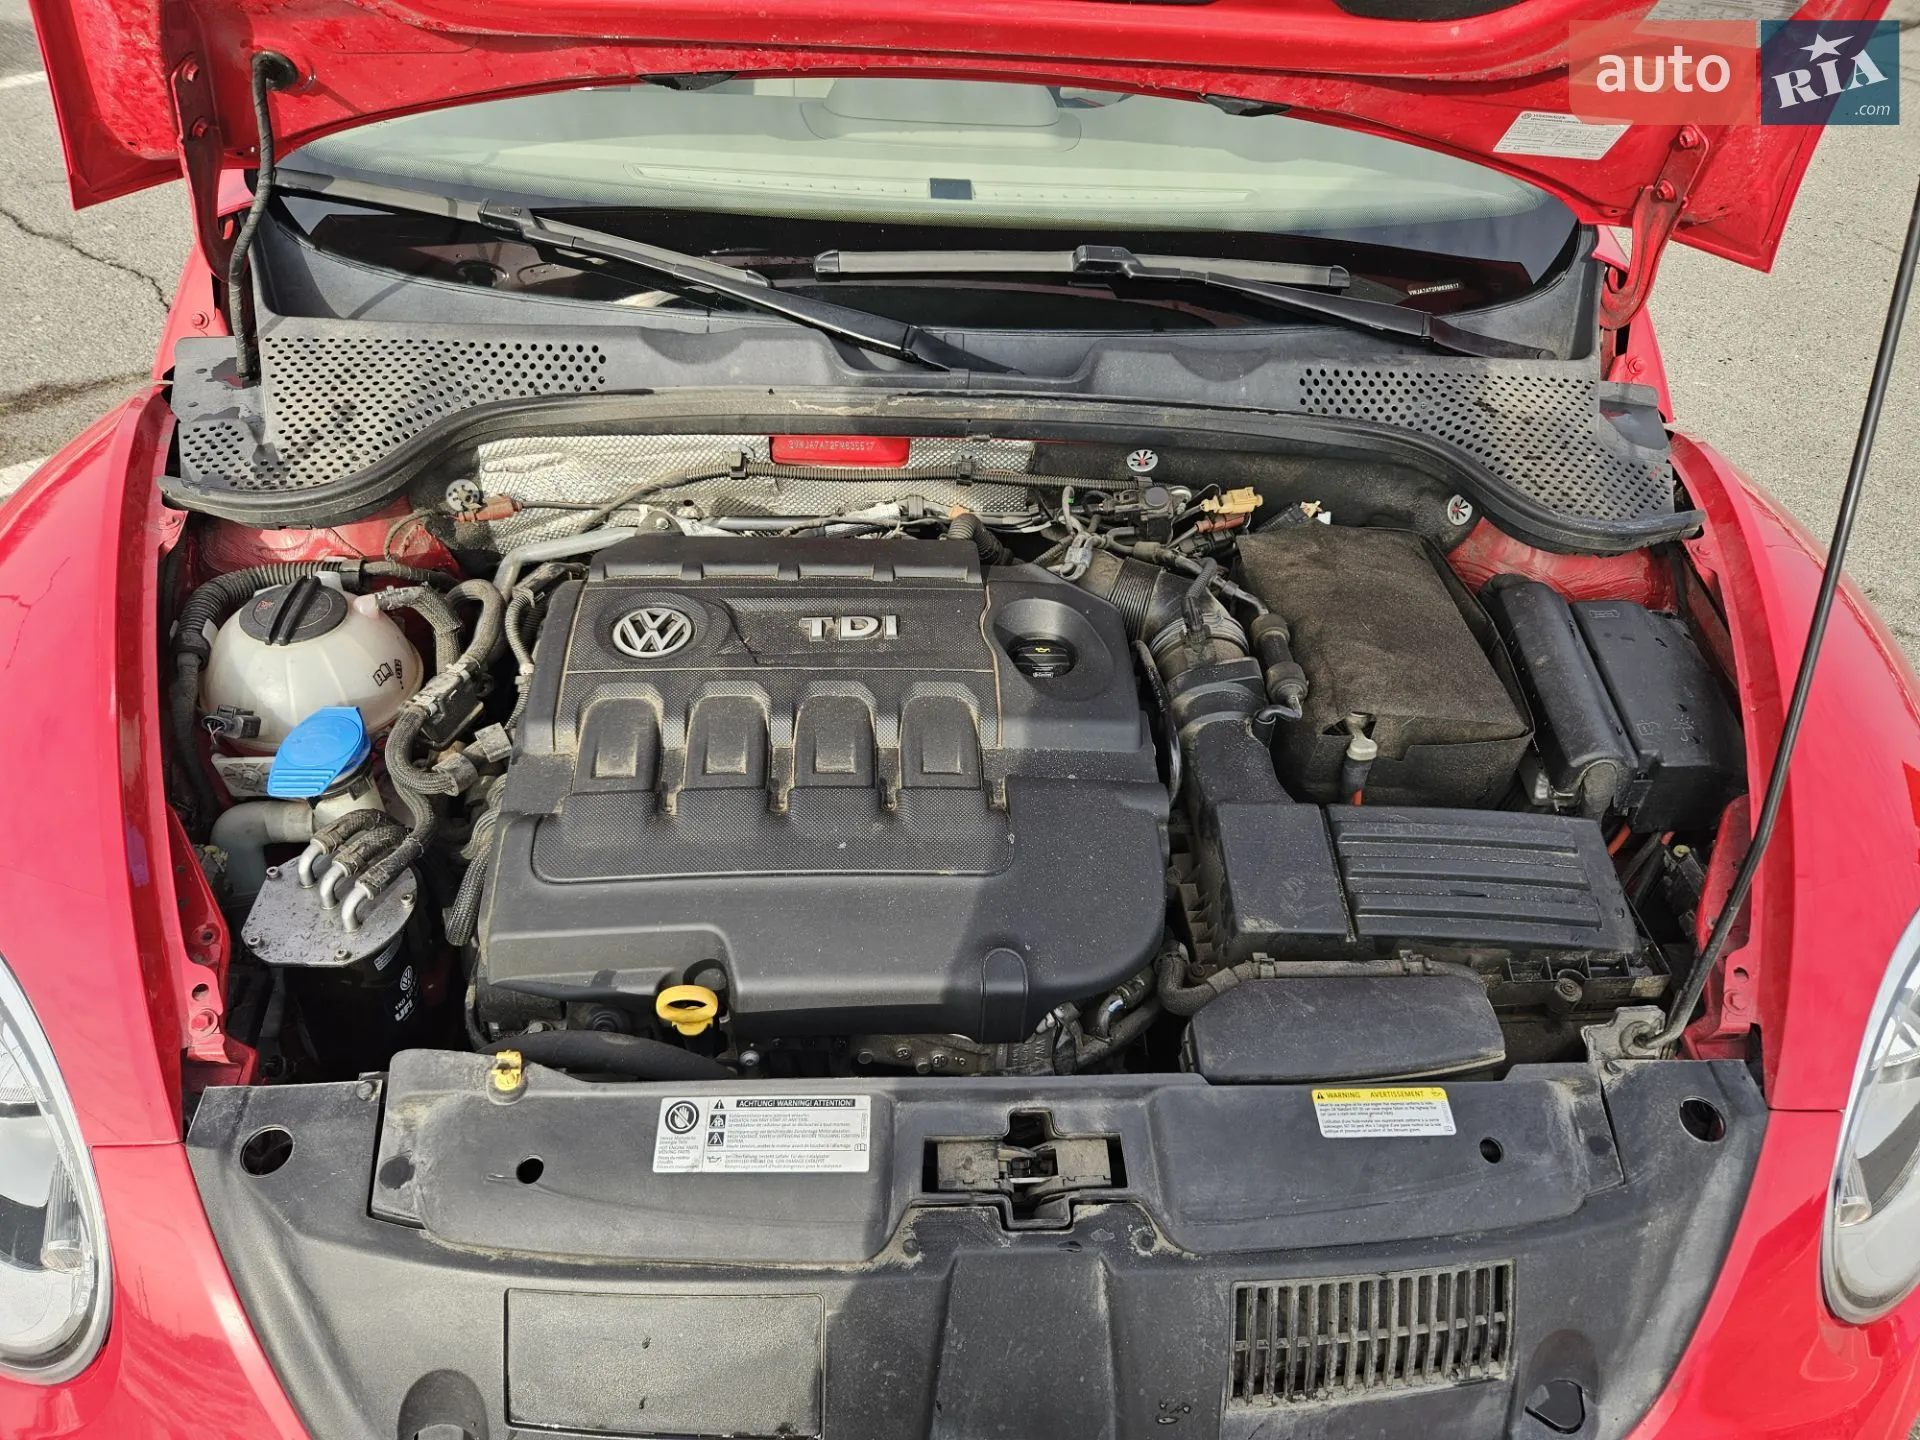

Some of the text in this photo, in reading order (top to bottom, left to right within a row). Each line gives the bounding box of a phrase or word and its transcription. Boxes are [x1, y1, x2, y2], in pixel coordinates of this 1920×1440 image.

[799, 614, 900, 642] TDI
[1370, 1090, 1425, 1098] AVERTISSEMENT
[739, 1099, 854, 1107] ACHTUNG! WARNING! ATTENTION!
